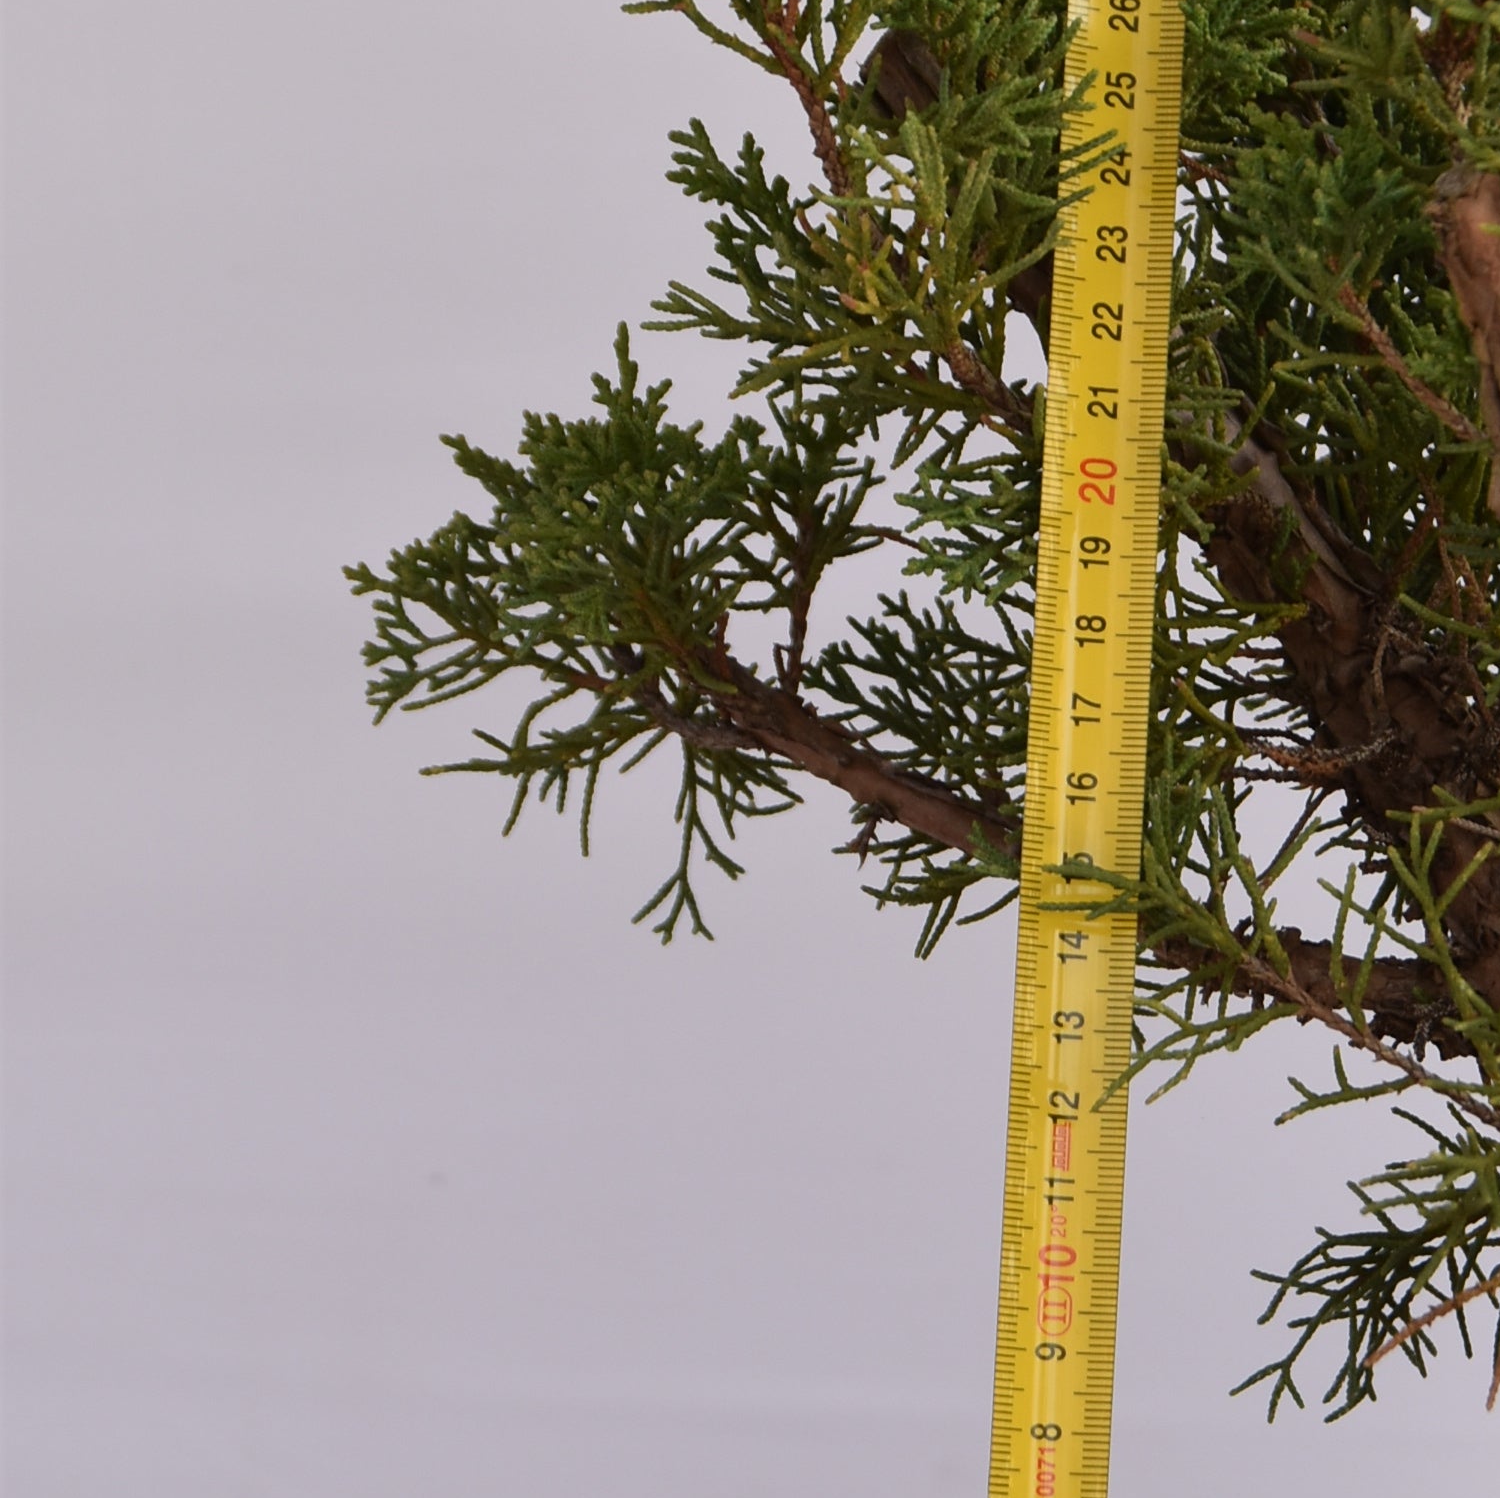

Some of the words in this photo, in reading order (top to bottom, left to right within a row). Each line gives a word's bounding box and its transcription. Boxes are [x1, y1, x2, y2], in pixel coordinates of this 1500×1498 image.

[1104, 72, 1136, 109] 25
[1099, 148, 1132, 186] 24
[1096, 226, 1128, 263] 23
[1091, 302, 1123, 341] 22
[1087, 386, 1118, 419] 21
[1079, 458, 1117, 505] 20
[1079, 537, 1111, 569] 19
[1074, 615, 1106, 648] 18
[1070, 693, 1101, 726] 17
[1066, 772, 1098, 805] 16
[1057, 930, 1089, 964] 14
[1053, 1011, 1084, 1044] 13
[1047, 1090, 1080, 1125] 12
[1043, 1176, 1075, 1205] 11
[1037, 1243, 1077, 1289] 10
[1035, 1342, 1066, 1361] 9
[1031, 1423, 1062, 1441] 8
[1035, 1446, 1056, 1498] 0071
